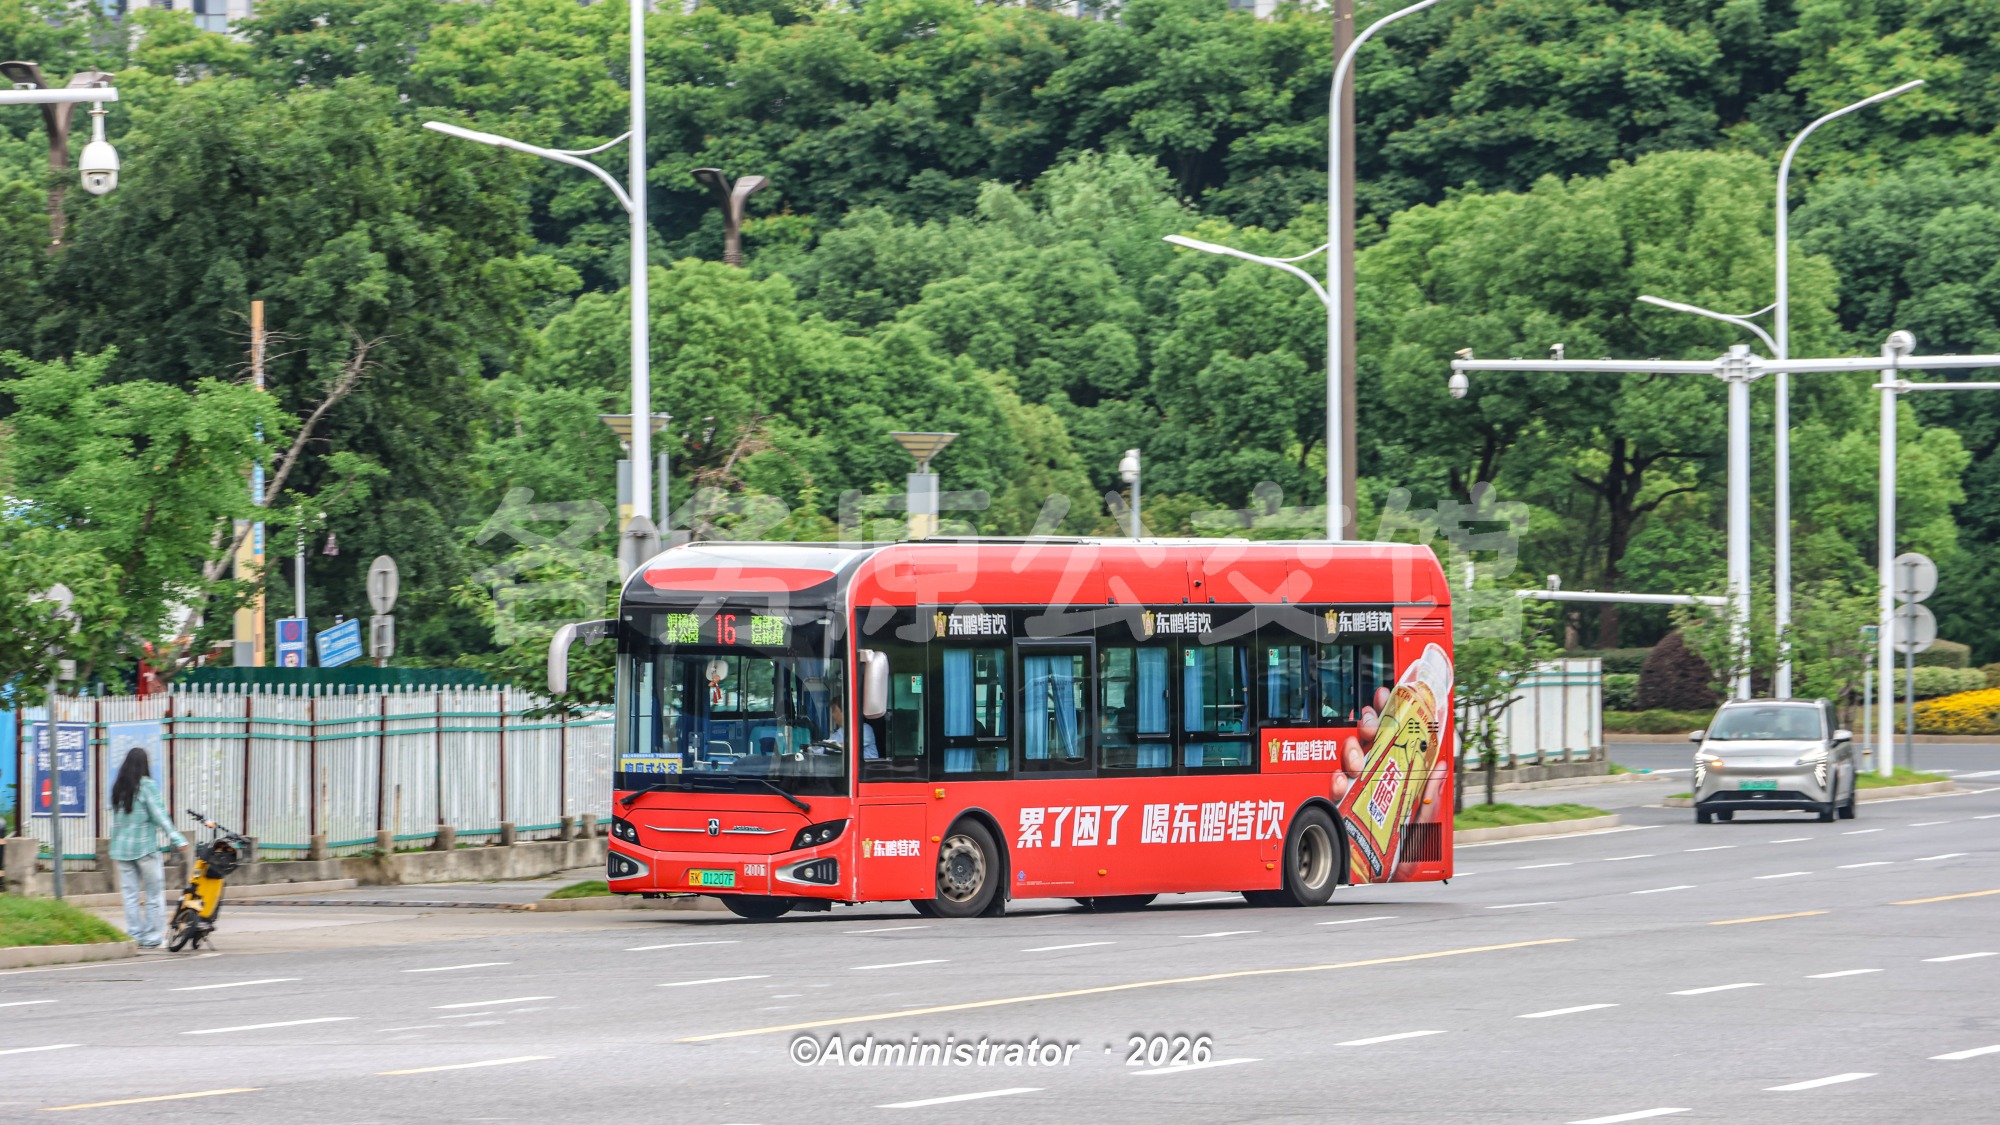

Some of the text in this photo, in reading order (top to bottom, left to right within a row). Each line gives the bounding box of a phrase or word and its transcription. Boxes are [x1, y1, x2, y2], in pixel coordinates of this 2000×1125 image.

[715, 614, 737, 645] 16
[948, 613, 1007, 635] 东鹏特饮
[1156, 611, 1212, 634] 东鹏特饮
[1339, 610, 1393, 633] 东鹏特饮
[1282, 740, 1337, 761] 东鹏特饮
[1016, 799, 1285, 848] 累了困了 喝东鹏特饮
[873, 839, 920, 858] 东鹏特饮
[745, 864, 766, 877] 2001
